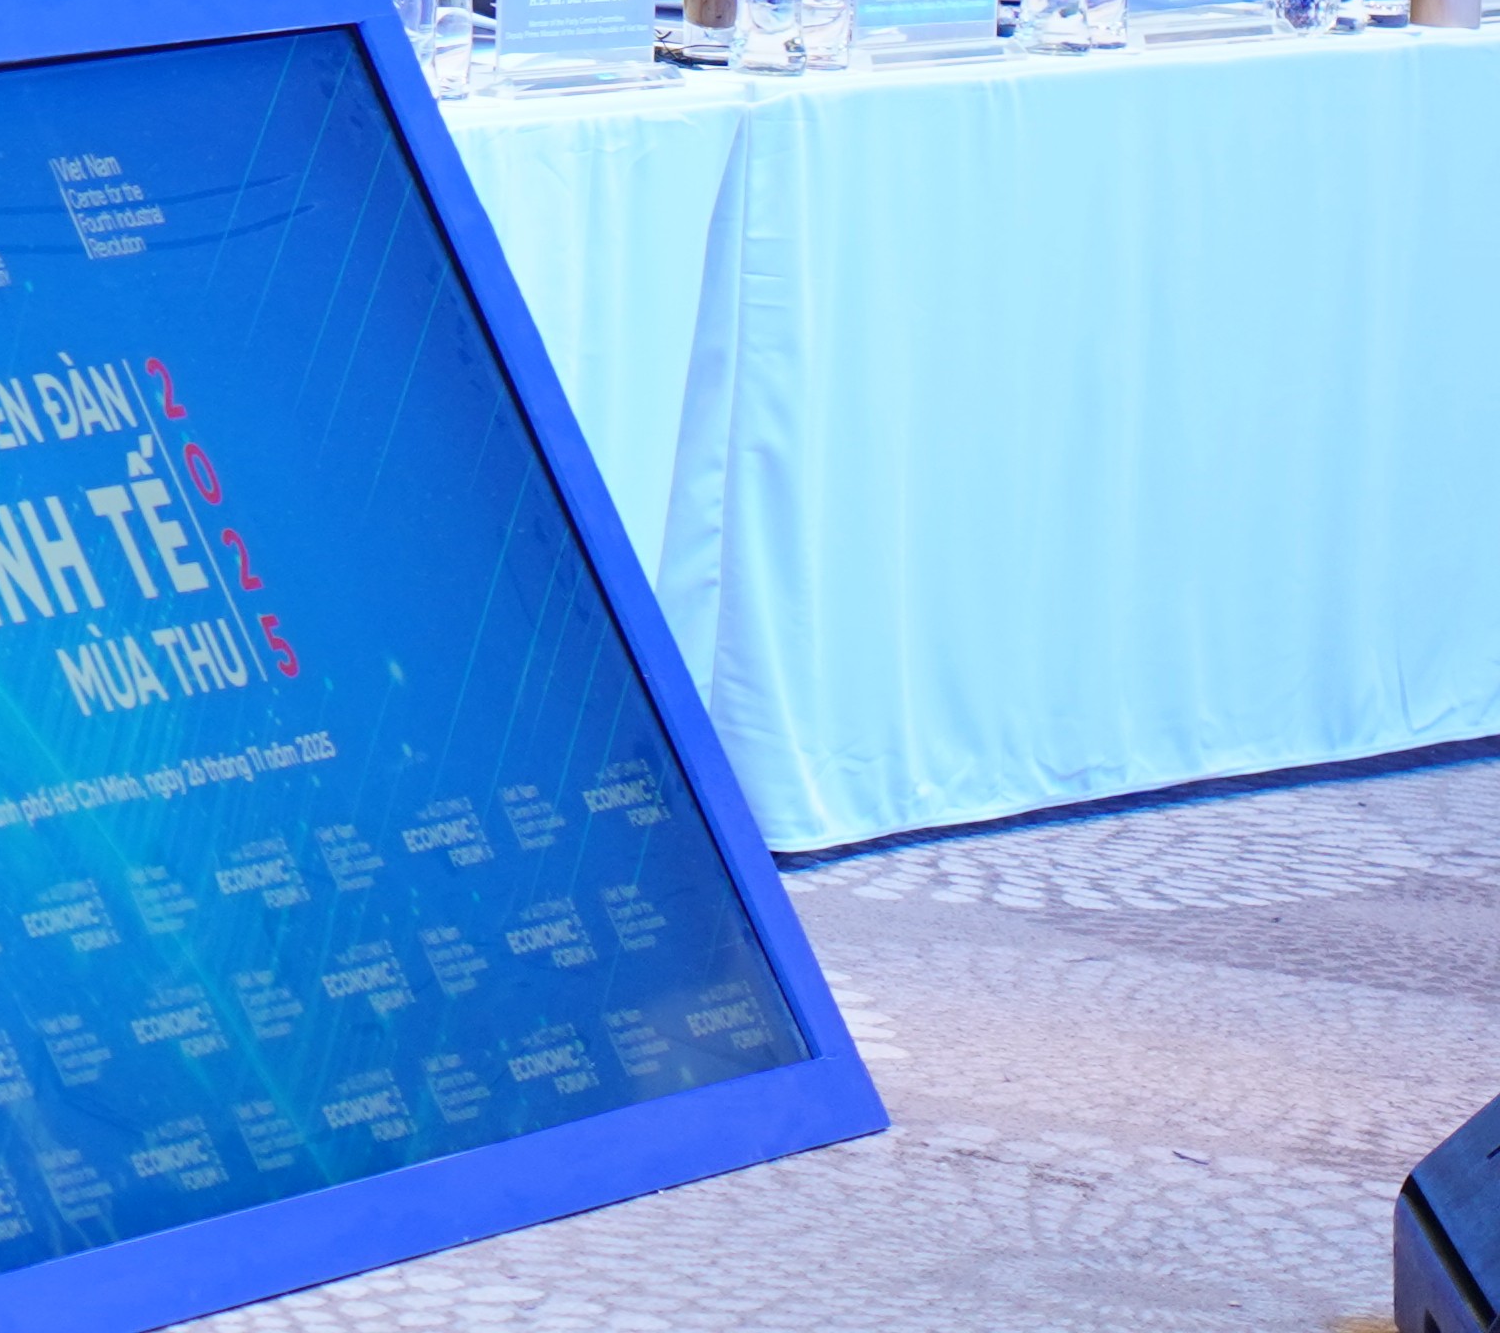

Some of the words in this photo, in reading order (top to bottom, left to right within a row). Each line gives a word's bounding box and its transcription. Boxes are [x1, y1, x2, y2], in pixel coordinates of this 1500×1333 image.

[52, 157, 88, 183] Viet
[83, 153, 123, 178] Nam
[32, 351, 139, 440] ĐÀN
[84, 433, 210, 600] TẾ
[56, 623, 170, 717] MÙA
[151, 618, 249, 697] THU
[295, 730, 338, 763] 2025
